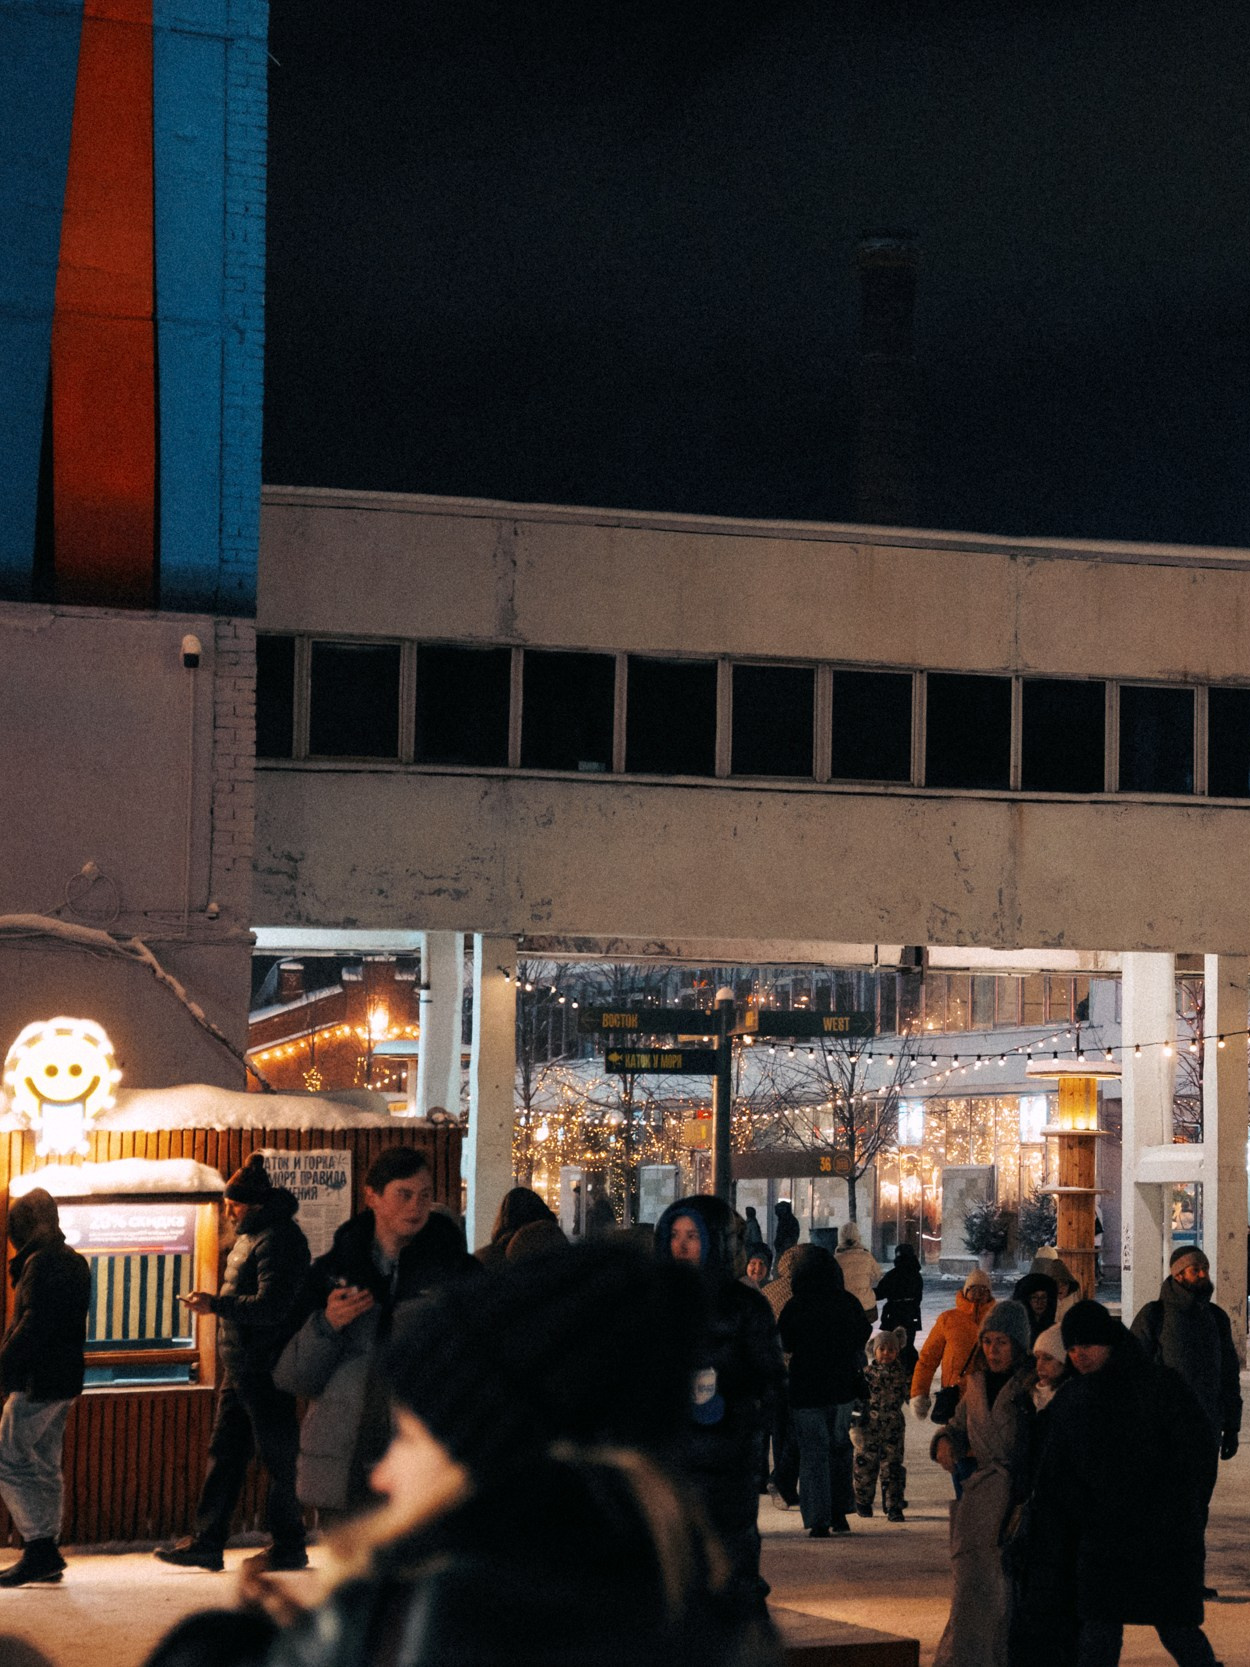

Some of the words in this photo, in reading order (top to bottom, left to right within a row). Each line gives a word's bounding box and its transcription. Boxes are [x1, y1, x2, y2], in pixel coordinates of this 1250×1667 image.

[602, 1012, 638, 1029] ВОСТОК
[822, 1016, 851, 1032] WEST
[624, 1053, 650, 1069] КАТОК
[660, 1053, 683, 1070] МОРЯ
[264, 1155, 289, 1170] АТОК
[293, 1155, 301, 1170] И
[304, 1155, 335, 1170] ГОРКА
[819, 1156, 832, 1172] 36
[300, 1170, 347, 1186] ПРАВИЛА
